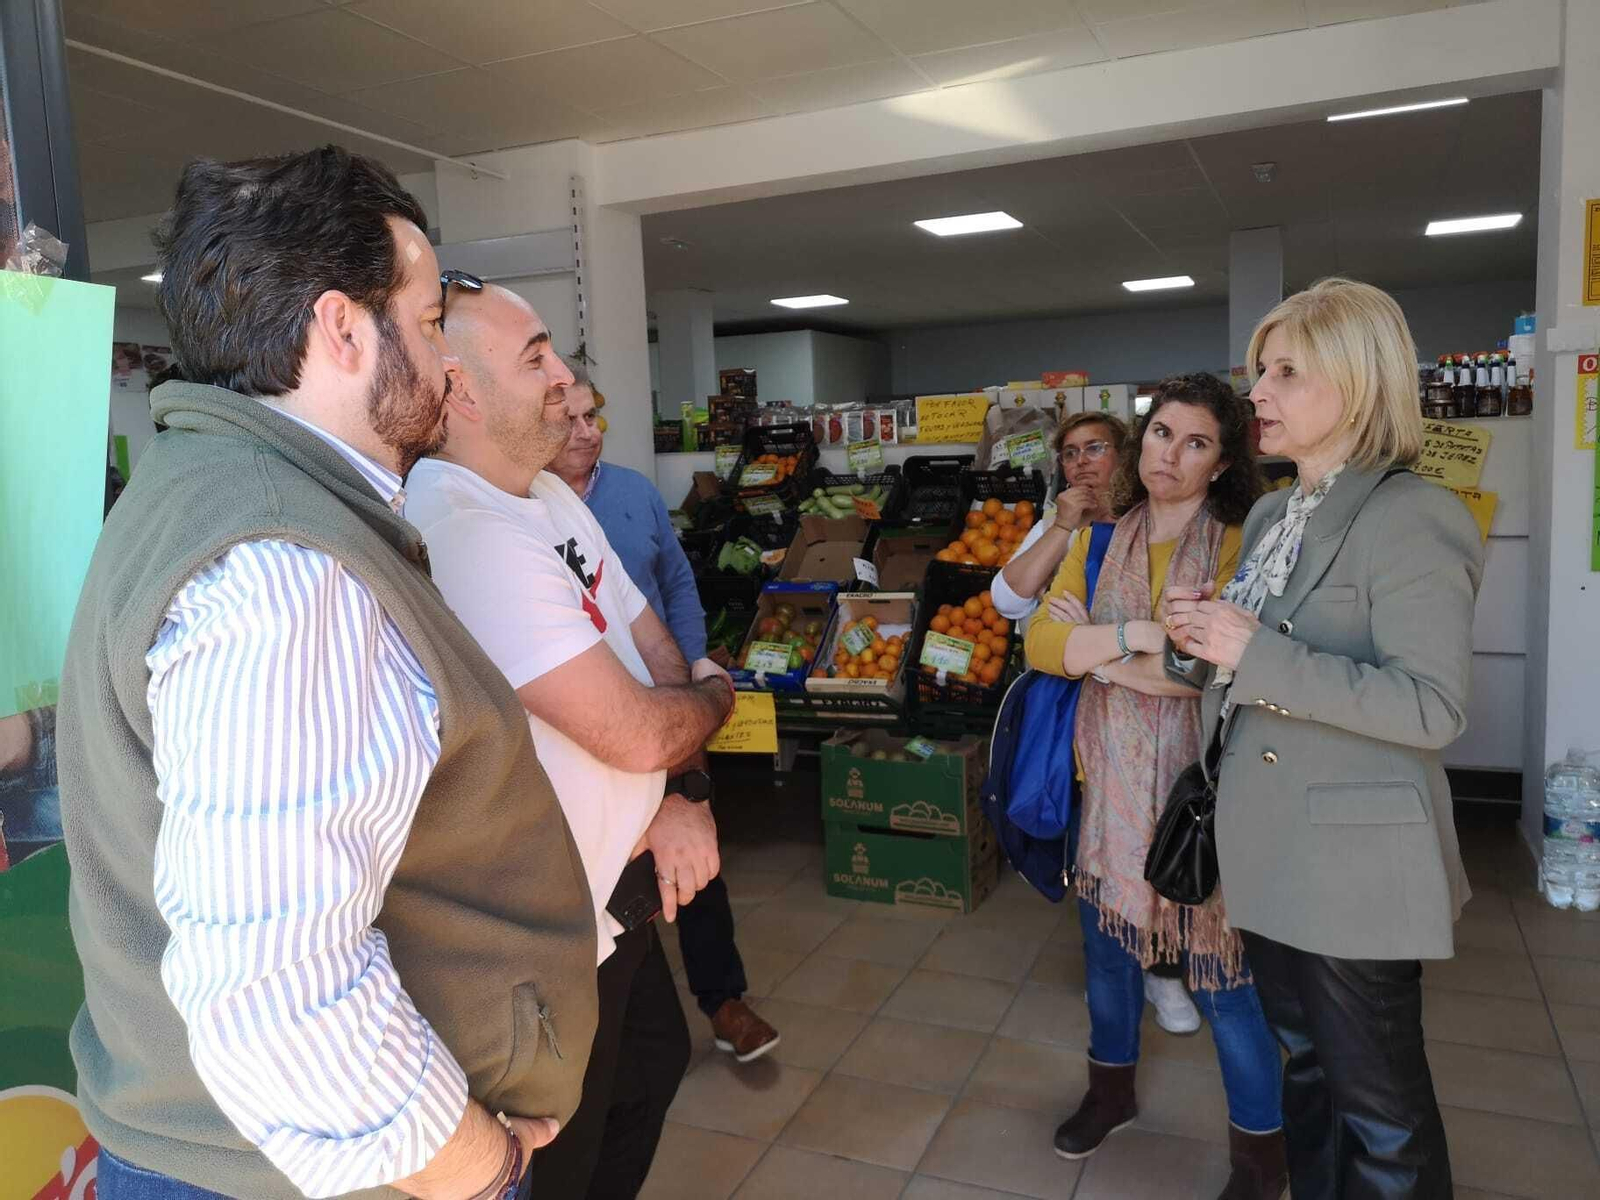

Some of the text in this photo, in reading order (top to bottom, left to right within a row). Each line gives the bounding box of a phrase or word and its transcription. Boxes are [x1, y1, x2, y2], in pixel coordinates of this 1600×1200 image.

[944, 399, 976, 409] FAVOR
[931, 409, 967, 419] TOCAR
[1422, 422, 1473, 437] FERTA
[828, 797, 884, 813] SOLANUM
[833, 873, 889, 889] SOLANUM
